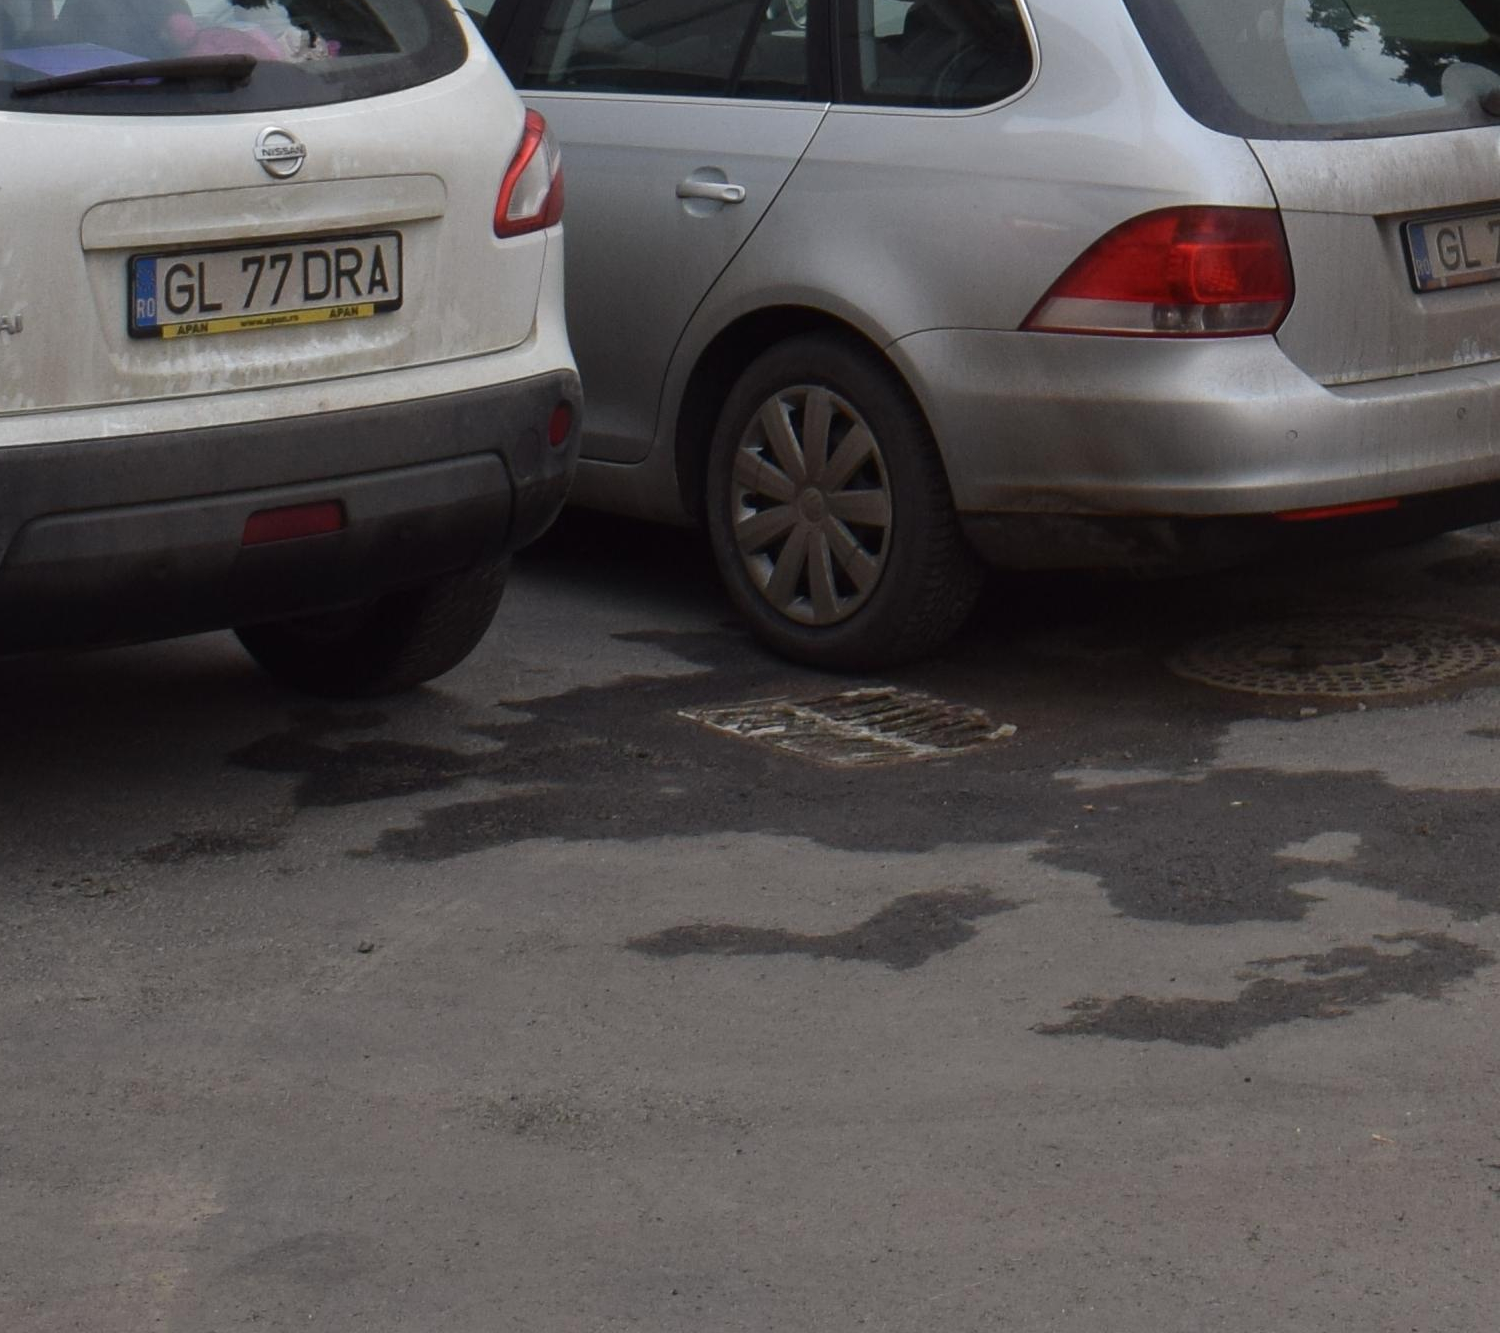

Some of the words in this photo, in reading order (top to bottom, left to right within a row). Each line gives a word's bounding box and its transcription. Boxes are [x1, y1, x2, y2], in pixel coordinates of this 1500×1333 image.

[261, 144, 304, 156] NISSAN
[1436, 225, 1481, 271] GL
[164, 261, 223, 315] GL
[241, 253, 294, 309] 77
[302, 245, 389, 301] DRA
[136, 298, 156, 318] RO
[176, 323, 209, 335] APAN
[329, 306, 359, 318] APAN
